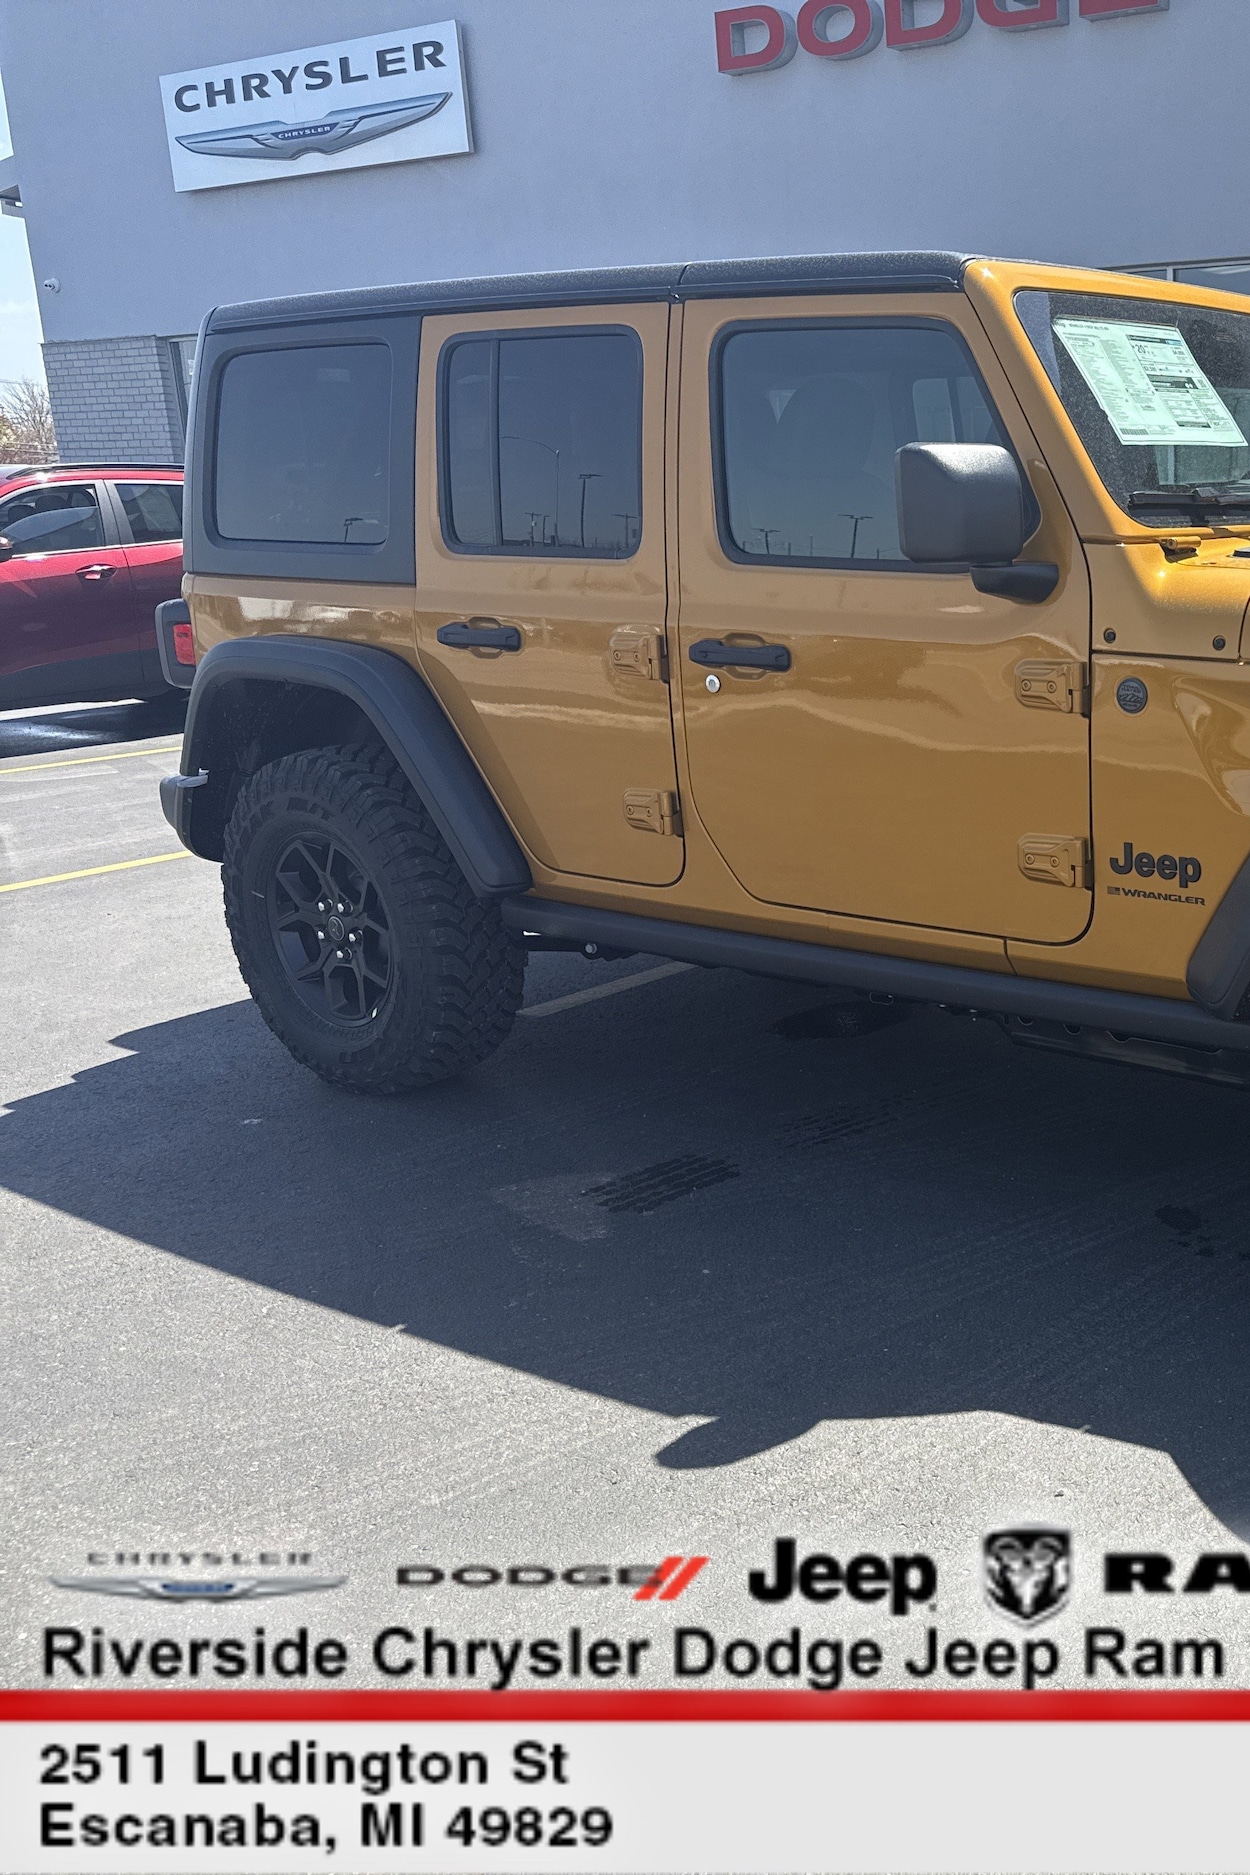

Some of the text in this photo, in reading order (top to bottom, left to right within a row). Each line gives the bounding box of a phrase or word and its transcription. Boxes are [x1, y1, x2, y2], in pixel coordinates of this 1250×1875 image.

[714, 0, 1165, 74] DOD
[174, 40, 447, 113] CHRYSLER
[277, 125, 333, 140] CHRYSLER
[1109, 841, 1203, 889] Jeep
[1121, 887, 1206, 906] WRANGLER
